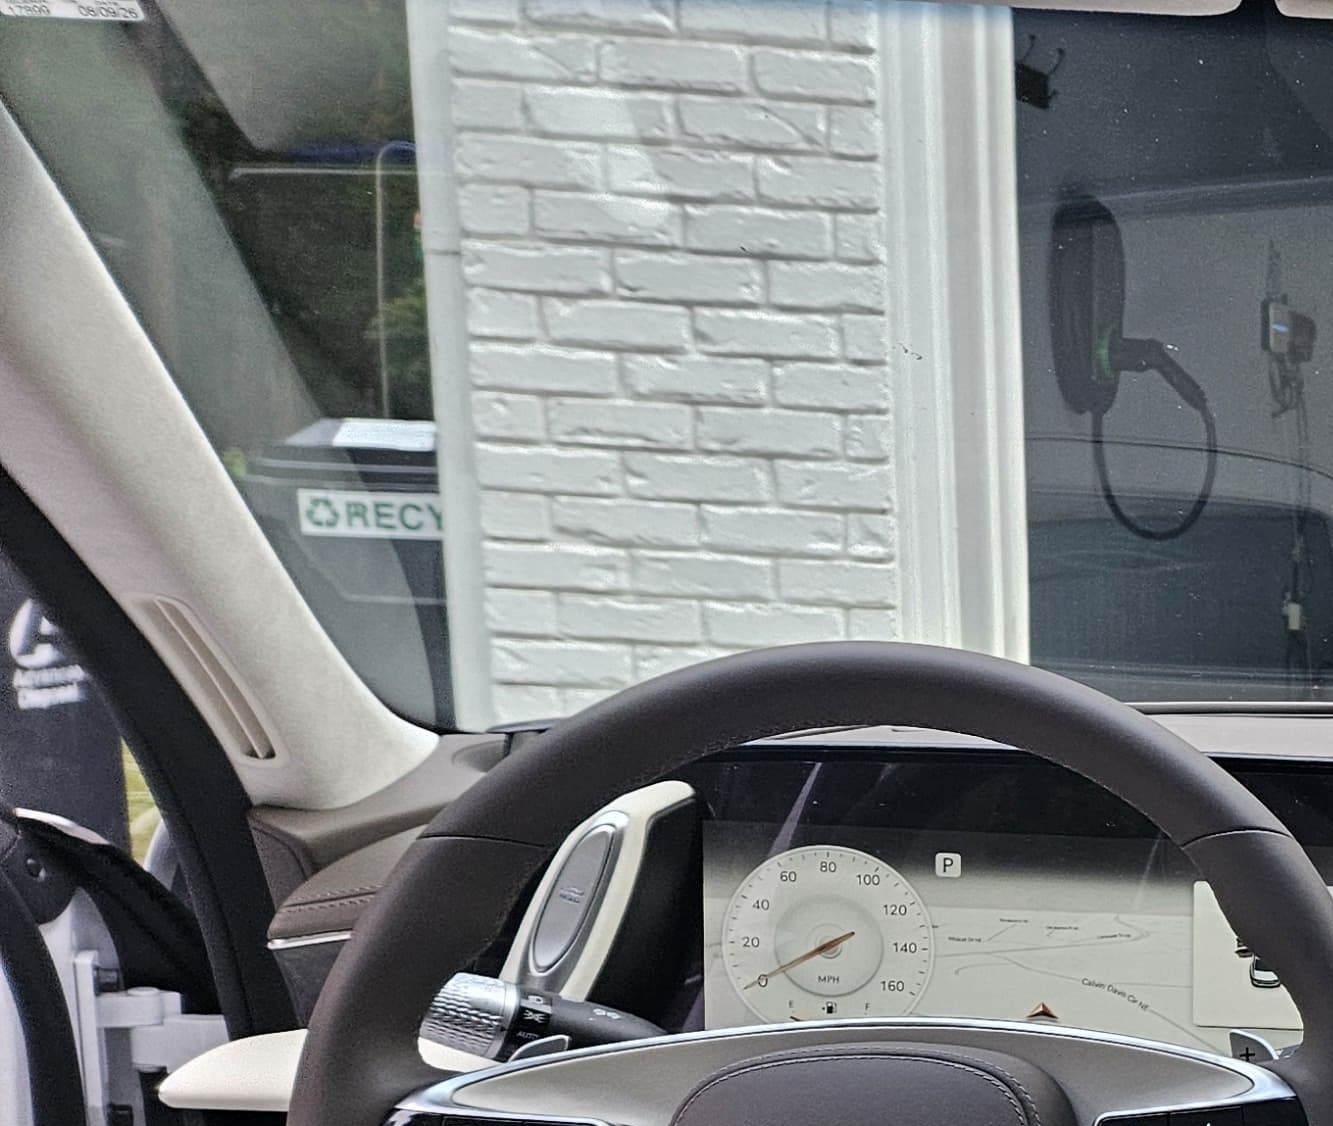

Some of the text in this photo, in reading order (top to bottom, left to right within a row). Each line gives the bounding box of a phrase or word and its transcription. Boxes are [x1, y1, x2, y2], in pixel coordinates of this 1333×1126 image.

[345, 501, 443, 531] RECY
[819, 861, 837, 873] 80
[942, 858, 954, 873] P
[780, 871, 797, 882] 60
[856, 873, 881, 886] 100
[752, 899, 770, 911] 40
[883, 904, 907, 917] 120
[742, 935, 760, 948] 20
[894, 943, 918, 954] 140
[817, 975, 840, 984] MPH
[881, 981, 905, 993] 160
